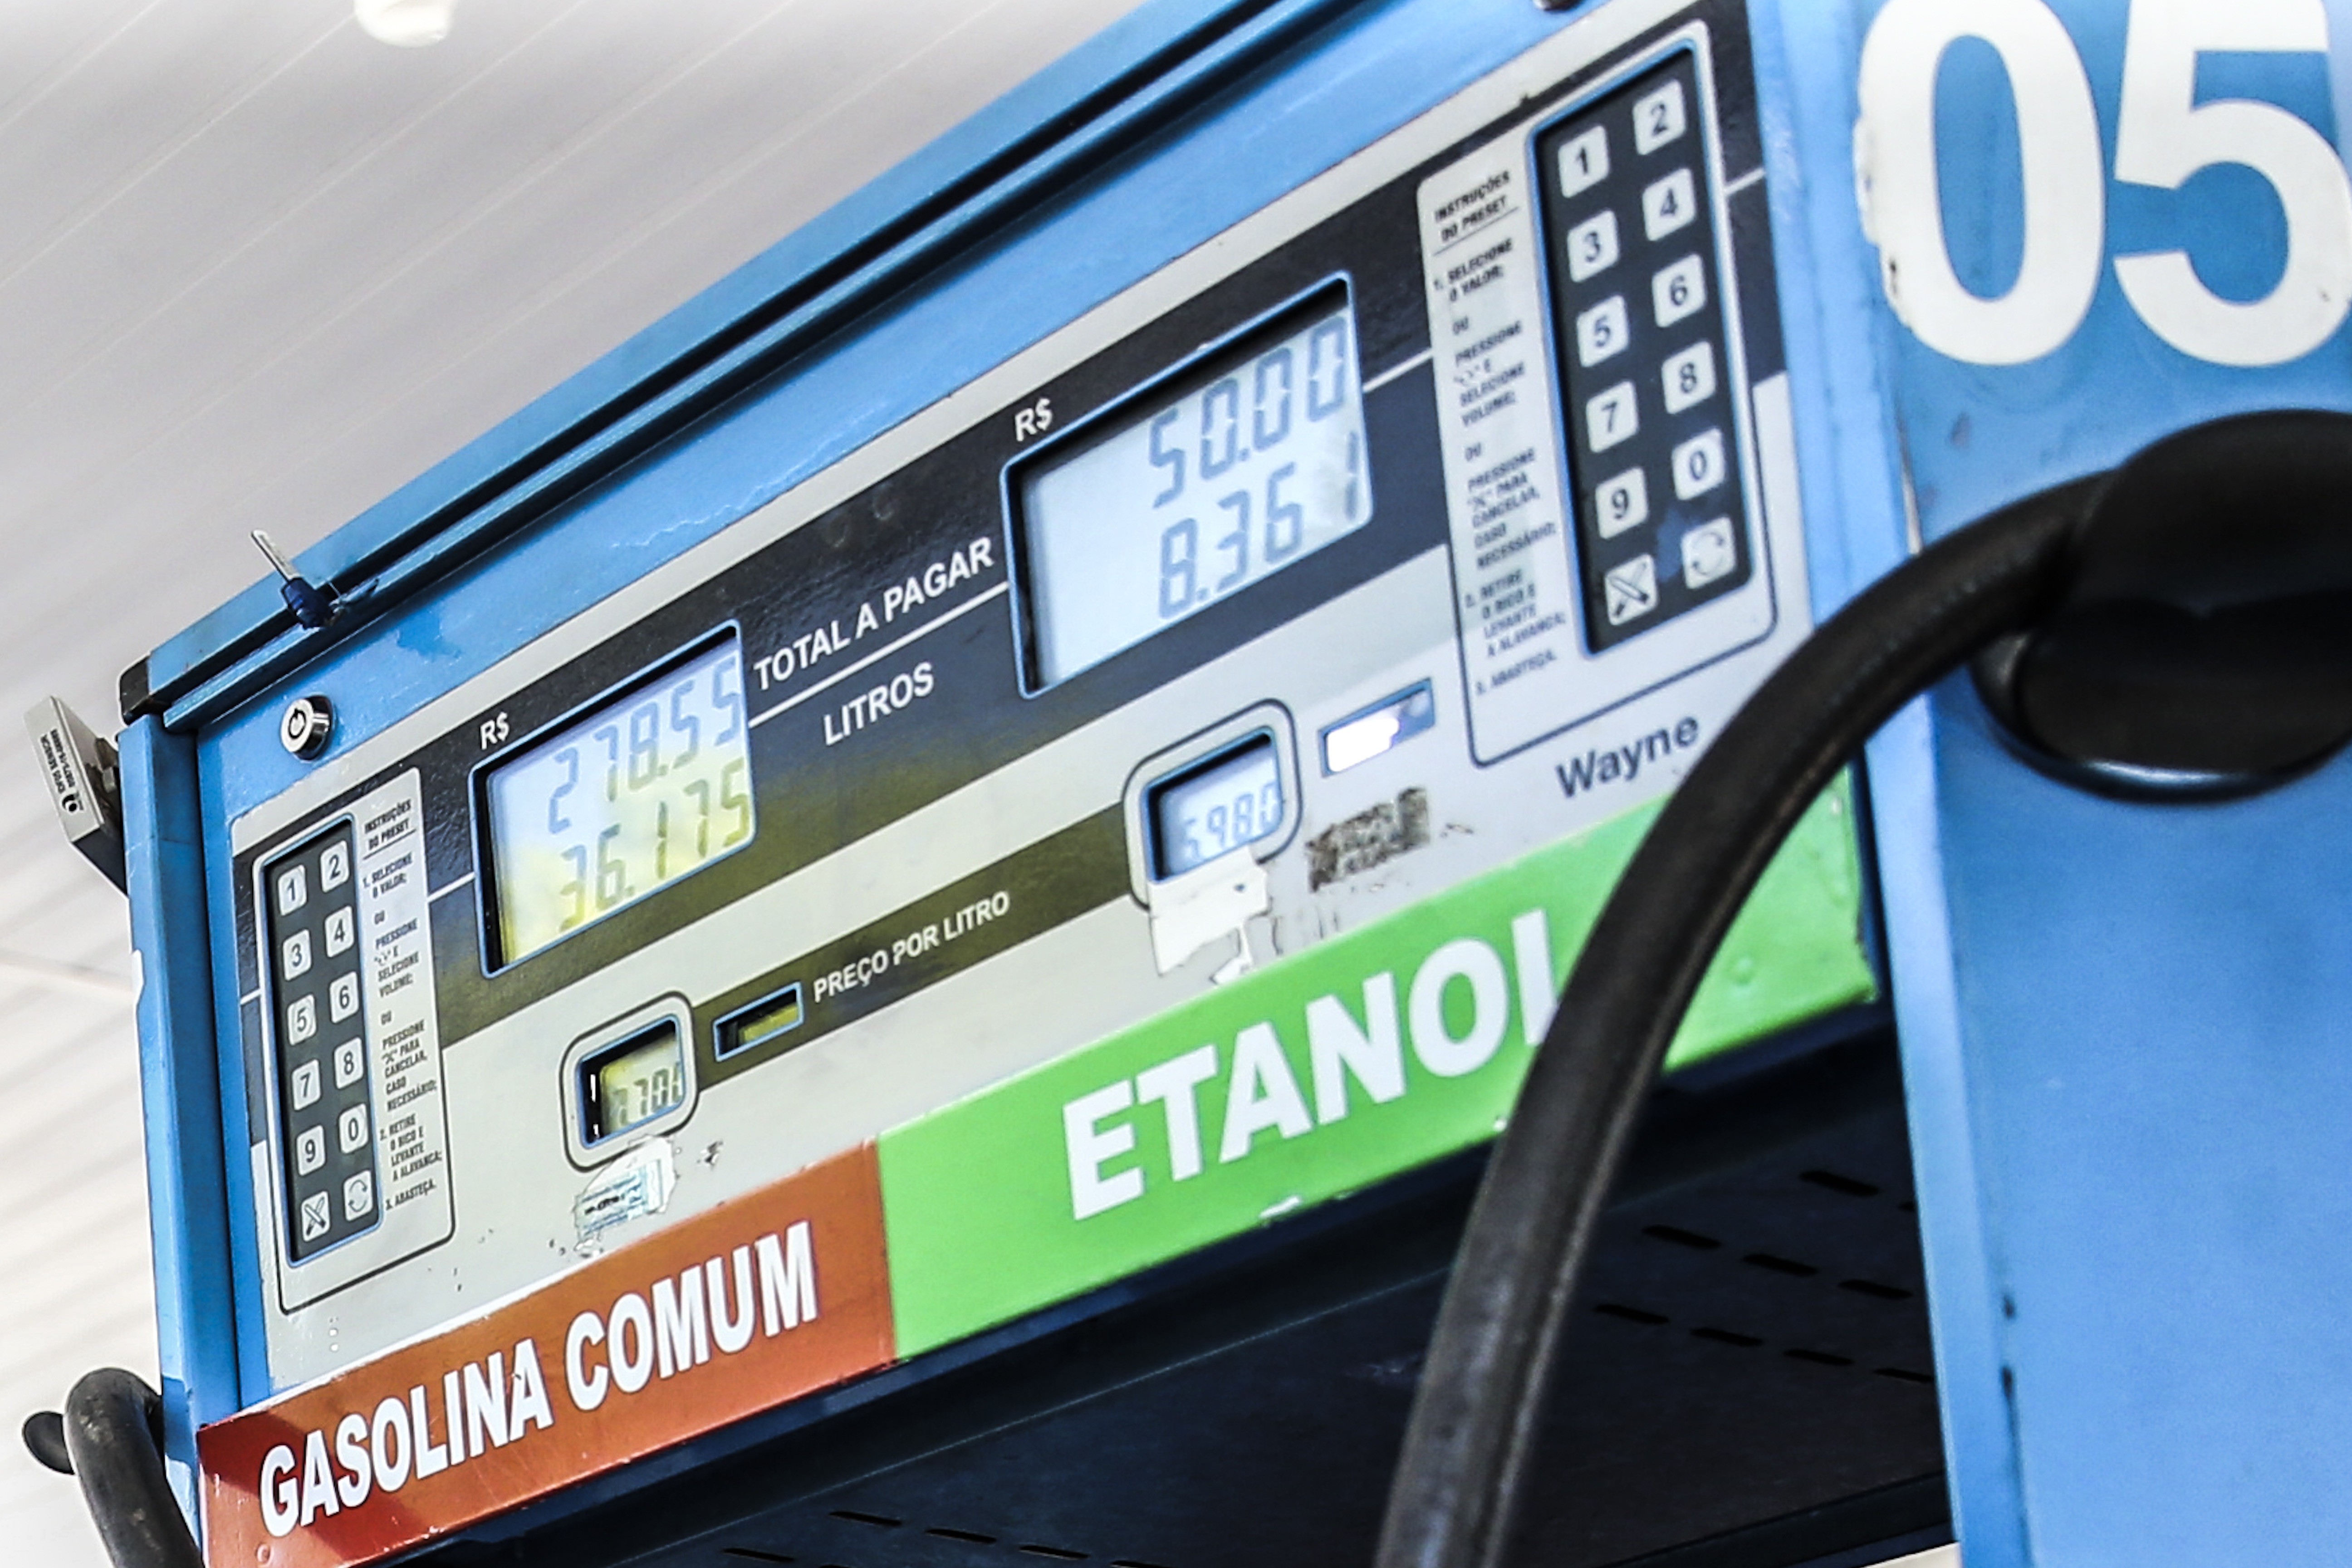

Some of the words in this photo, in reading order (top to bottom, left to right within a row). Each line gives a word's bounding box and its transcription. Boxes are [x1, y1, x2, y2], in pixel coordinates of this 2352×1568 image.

[1651, 103, 1667, 135] 2
[1575, 146, 1588, 175] 1
[1435, 170, 1510, 222] INSTRUÇÕES
[1852, 0, 2352, 367] 05
[1462, 196, 1507, 230] PRESET
[1660, 187, 1677, 217] 4
[1585, 231, 1600, 263] 3
[1670, 275, 1687, 306] 6
[1594, 314, 1610, 348] 5
[1680, 363, 1696, 394] 8
[1014, 398, 1053, 441] R$
[1149, 317, 1346, 510] 50.00
[1601, 401, 1617, 432] 7
[1689, 450, 1706, 480] 0
[1612, 489, 1628, 519] 9
[753, 620, 850, 690] TOTAL
[855, 602, 878, 639] A
[883, 536, 995, 622] PAGAR
[823, 661, 934, 746] LITROS
[480, 712, 510, 750] R$
[549, 655, 741, 835] 278.55
[1555, 716, 1698, 798] Wayne
[365, 799, 412, 834] INSTRUÇÕES
[369, 835, 379, 851] DO
[382, 819, 409, 845] PRESET
[559, 756, 750, 933] 36.175
[329, 854, 340, 880] 2
[372, 852, 412, 884] SELECIONE
[287, 879, 296, 901] 1
[334, 920, 344, 942] 4
[374, 911, 385, 925] OU
[376, 918, 417, 948] PRESSIONE
[291, 945, 301, 967] 3
[813, 950, 888, 1003] PREÇO
[892, 924, 940, 965] POR
[943, 890, 1010, 941] LITRO
[378, 952, 419, 982] SELECIONE
[339, 986, 350, 1009] 6
[296, 1009, 308, 1032] 5
[381, 1011, 392, 1025] OU
[382, 1019, 425, 1049] PRESSIONE
[343, 1050, 354, 1075] 8
[300, 1073, 310, 1098] 7
[386, 1076, 406, 1094] CASO
[348, 1117, 358, 1141] 0
[389, 1114, 416, 1137] RETIRE
[305, 1139, 316, 1163] 9
[391, 1142, 425, 1166] LEVANTE
[260, 1338, 554, 1537] GASOLINA
[565, 1221, 818, 1411] COMUM
